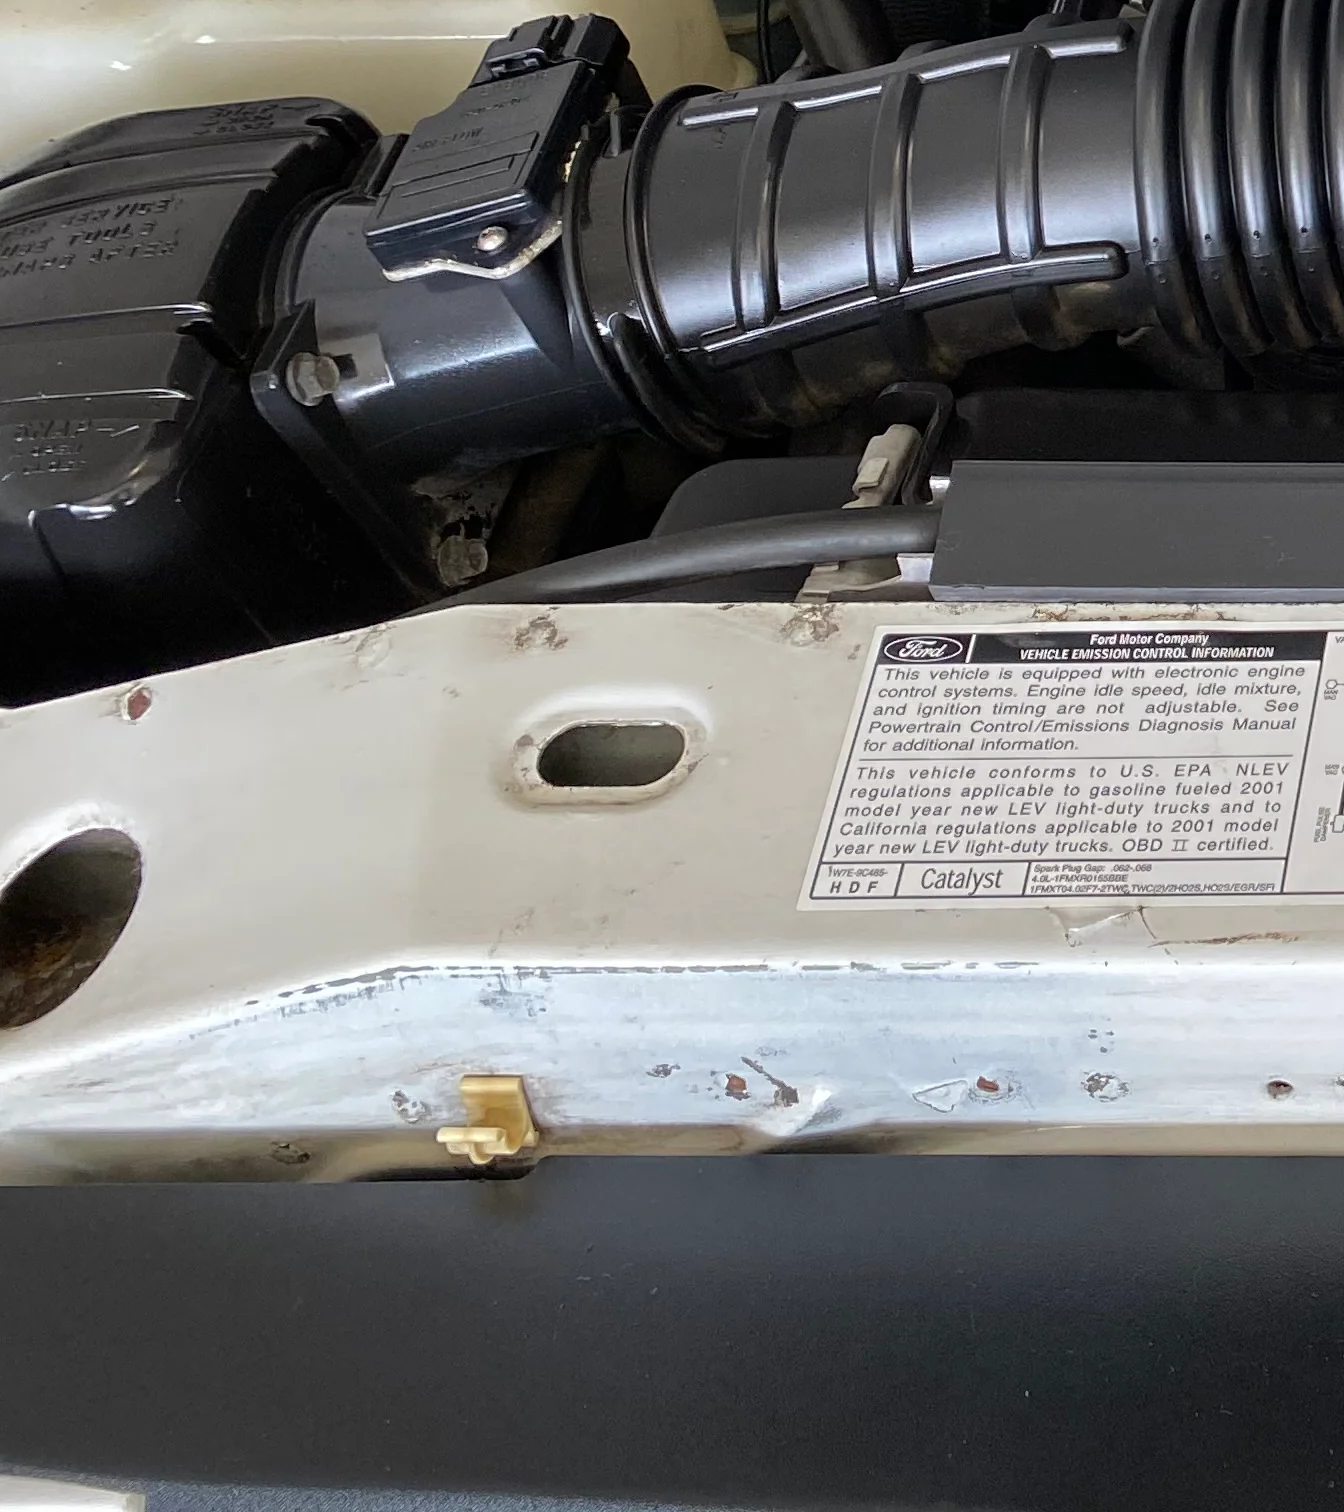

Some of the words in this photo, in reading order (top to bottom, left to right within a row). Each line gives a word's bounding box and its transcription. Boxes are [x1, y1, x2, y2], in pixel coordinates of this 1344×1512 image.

[1089, 633, 1117, 645] Ford
[1118, 633, 1153, 644] Motor
[1154, 632, 1209, 646] Company
[897, 639, 948, 659] Ford
[1020, 648, 1069, 659] VEHICLE
[1071, 647, 1130, 659] EMISSION
[1132, 647, 1188, 659] CONTROL
[1191, 646, 1274, 658] INFORMATION
[885, 668, 920, 680] This
[929, 667, 989, 680] vehicle
[998, 667, 1012, 679] is
[1021, 666, 1102, 682] equipped
[1111, 666, 1144, 678] with
[1154, 665, 1238, 678] electronic
[1247, 664, 1305, 680] engine
[878, 684, 937, 697] control
[943, 685, 1017, 700] systems.
[1026, 683, 1085, 699] Engine
[1093, 683, 1123, 696] idle
[1131, 683, 1187, 699] speed,
[1196, 682, 1226, 695] idle
[1233, 682, 1300, 696] mixture,
[872, 702, 907, 715] and
[916, 702, 981, 718] ignition
[992, 701, 1046, 717] timing
[1056, 704, 1085, 714] are
[1095, 702, 1124, 714] not
[1144, 699, 1241, 716] adjustable.
[1264, 699, 1298, 712] See
[868, 720, 960, 733] Powertrain
[970, 718, 1129, 732] Control/Emissions
[1138, 718, 1223, 733] Diagnosis
[1232, 717, 1296, 730] Manual
[863, 738, 887, 751] for
[891, 737, 974, 751] additional
[980, 737, 1078, 750] information.
[857, 766, 895, 779] This
[909, 765, 975, 779] vehicle
[988, 765, 1076, 778] conforms
[1089, 765, 1106, 777] to
[1120, 763, 1158, 777] U.S.
[1173, 763, 1211, 777] EPA
[1235, 762, 1289, 776] NLEV
[849, 784, 951, 800] regulations
[960, 783, 1053, 799] applicable
[1063, 783, 1080, 796] to
[1088, 782, 1165, 799] gasoline
[1175, 781, 1231, 795] fueled
[1239, 781, 1282, 794] 2001
[844, 803, 901, 816] model
[910, 805, 952, 818] year
[960, 805, 998, 815] new
[1008, 801, 1046, 815] LEV
[1055, 801, 1143, 817] light-duty
[1154, 800, 1209, 814] trucks
[1220, 799, 1254, 813] and
[1264, 800, 1281, 812] to
[839, 821, 926, 835] California
[935, 820, 1036, 836] regulations
[1044, 819, 1137, 836] applicable
[1146, 820, 1162, 832] to
[1170, 819, 1213, 832] 2001
[1223, 818, 1278, 831] model
[833, 843, 874, 856] year
[879, 843, 916, 854] new
[922, 839, 960, 853] LEV
[965, 839, 1049, 855] light-duty
[1055, 838, 1112, 852] trucks.
[1122, 838, 1162, 852] OBD
[1171, 839, 1188, 851] II
[1196, 837, 1273, 851] certified.
[829, 881, 842, 894] H
[848, 881, 861, 894] D
[867, 881, 879, 894] F
[921, 867, 1004, 896] Catalyst
